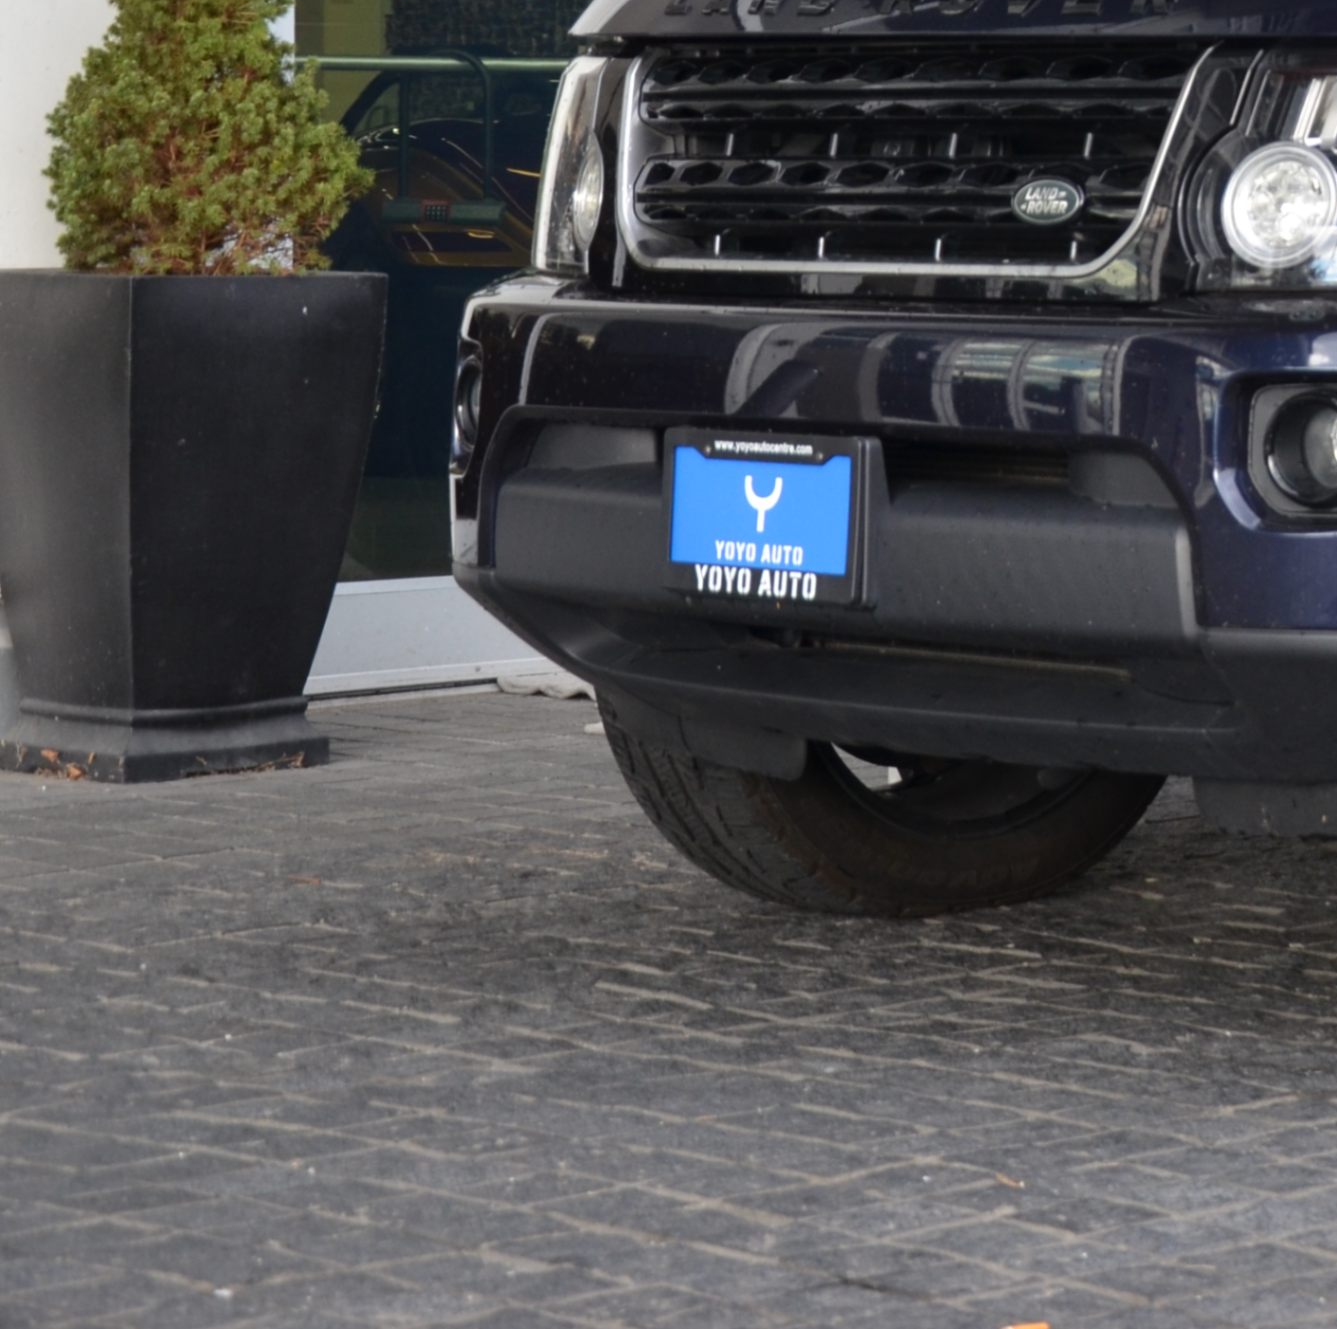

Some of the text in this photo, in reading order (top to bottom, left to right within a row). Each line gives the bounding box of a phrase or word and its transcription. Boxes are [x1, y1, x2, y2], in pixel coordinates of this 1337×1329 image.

[1025, 186, 1059, 200] LAND
[1026, 200, 1068, 214] ROVER
[715, 539, 804, 566] YOYO AUTO
[694, 563, 817, 601] YOYO AUTO
